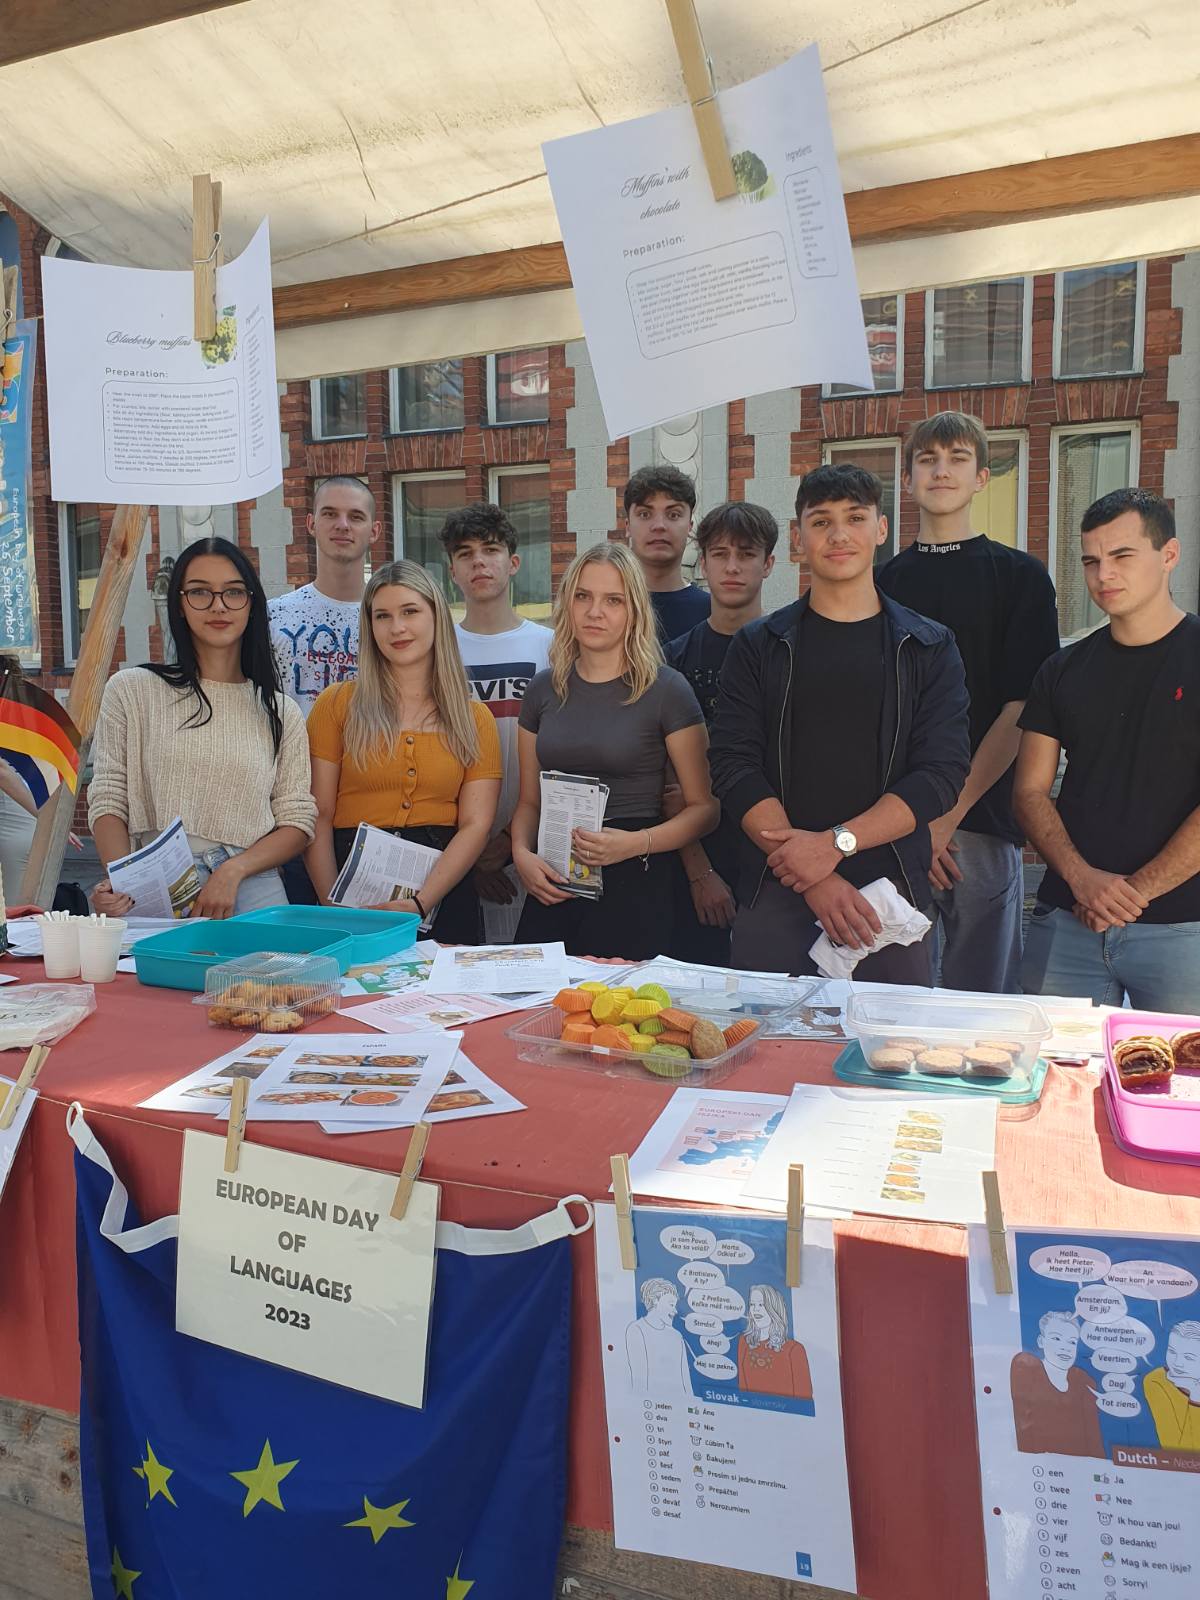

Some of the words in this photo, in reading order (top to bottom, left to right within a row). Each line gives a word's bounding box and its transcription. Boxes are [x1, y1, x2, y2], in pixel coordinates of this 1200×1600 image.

[621, 173, 664, 198] Muffins
[667, 166, 690, 185] with
[640, 198, 681, 220] chocolate
[622, 235, 686, 258] Preparation:
[106, 330, 156, 350] Blueberry
[158, 335, 192, 350] muffins
[105, 367, 168, 379] Preparation:
[918, 543, 929, 552] Los
[930, 543, 961, 554] Angeles
[1, 567, 15, 641] September
[307, 650, 358, 665] ELEGA
[465, 678, 530, 701] VI'S
[215, 1178, 327, 1222] EUROPEAN
[332, 1204, 379, 1232] DAY
[278, 1231, 306, 1252] OF
[1083, 1267, 1094, 1275] jij?
[230, 1255, 353, 1303] LANGUAGES
[1107, 1275, 1128, 1283] Waar
[1156, 1279, 1193, 1287] vandaan?
[1076, 1296, 1120, 1305] Amsterdam.
[1100, 1306, 1111, 1314] jij?
[265, 1303, 311, 1330] 2023
[1094, 1325, 1136, 1335] Antwerpen.
[1087, 1333, 1101, 1341] Hoe
[1098, 1354, 1131, 1363] Veertien.
[1108, 1380, 1126, 1389] Dag!
[705, 1390, 740, 1403] Slovak
[1101, 1398, 1114, 1407] Tot
[1115, 1400, 1138, 1409] ziens!
[1117, 1451, 1157, 1465] Dutch
[1048, 1470, 1064, 1478] een
[1114, 1476, 1124, 1485] Ja
[1050, 1485, 1071, 1494] twee
[1051, 1501, 1068, 1510] drie
[1115, 1496, 1133, 1505] Nee
[1052, 1517, 1068, 1526] vier
[1117, 1516, 1126, 1525] Ik
[1127, 1517, 1144, 1527] hou
[1146, 1520, 1162, 1529] van
[1164, 1521, 1181, 1531] jou!
[1053, 1533, 1068, 1543] vijf
[1119, 1536, 1157, 1549] Bedankt!
[1055, 1550, 1069, 1558] zes
[1056, 1566, 1081, 1575] zeven
[1121, 1557, 1140, 1569] Mag
[1141, 1559, 1150, 1569] ik
[1151, 1562, 1168, 1570] een
[1169, 1562, 1192, 1574] ijsje?
[1057, 1582, 1078, 1591] acht
[1122, 1577, 1149, 1589] Sorry!
